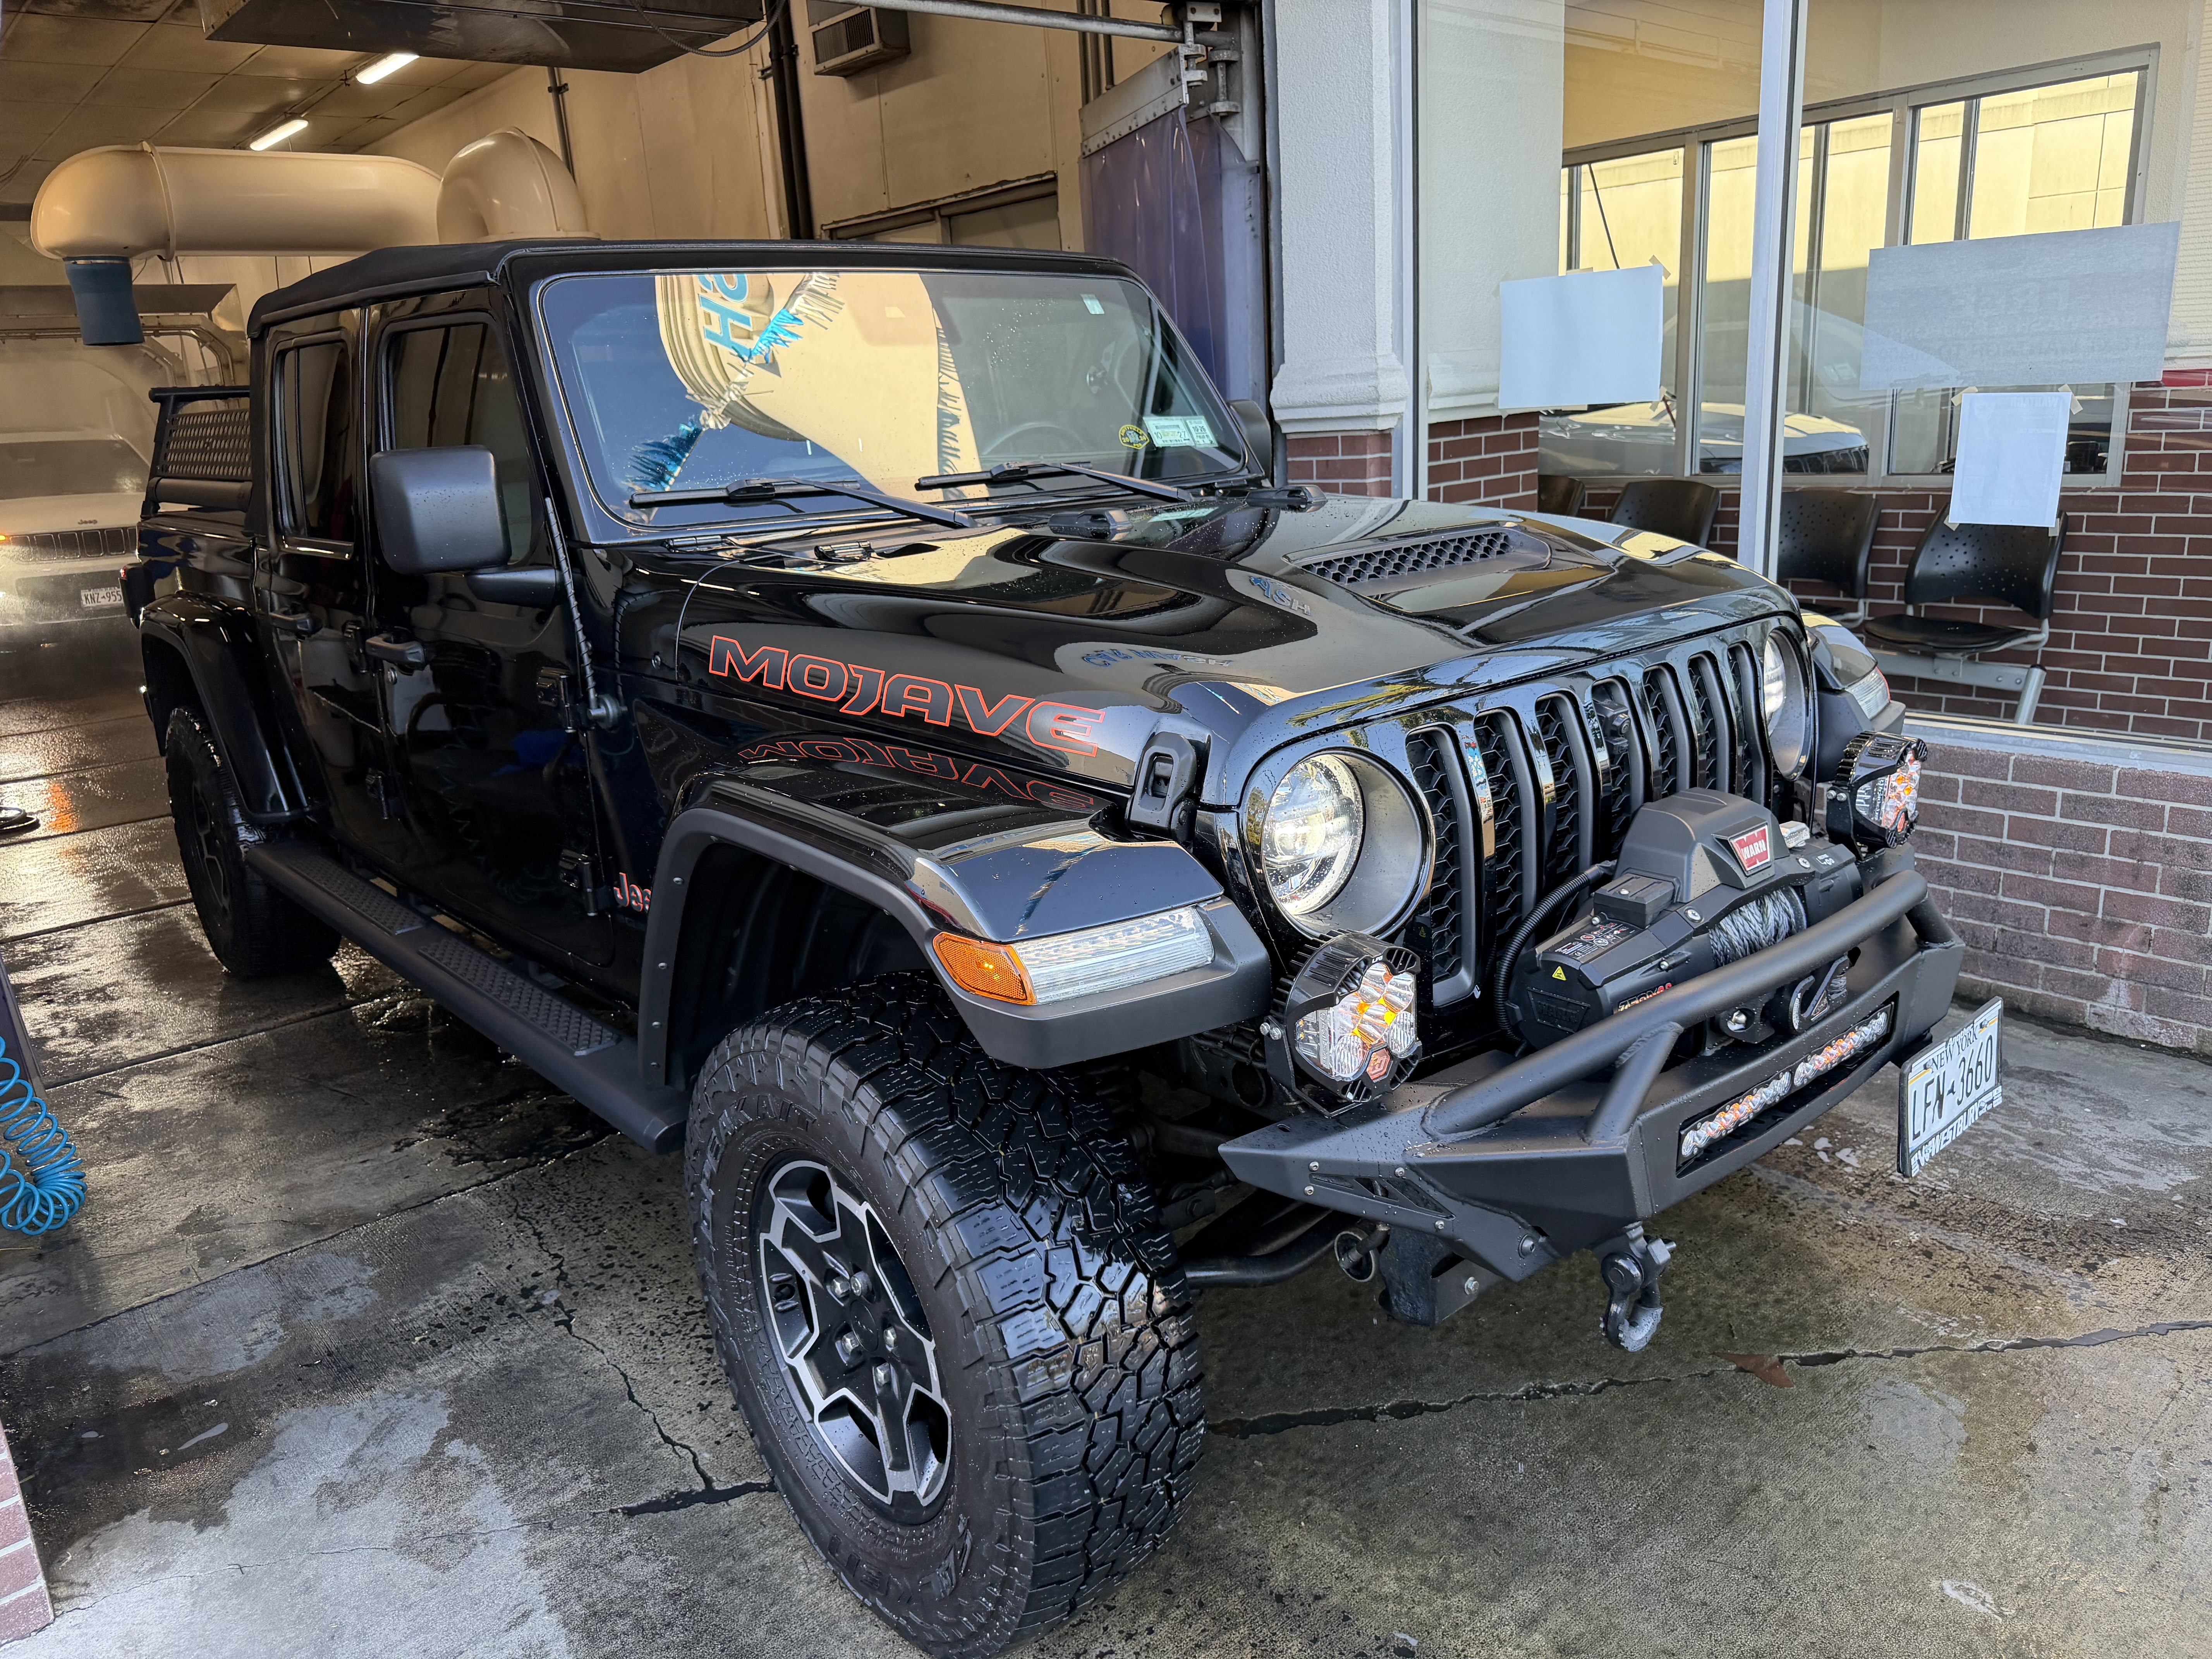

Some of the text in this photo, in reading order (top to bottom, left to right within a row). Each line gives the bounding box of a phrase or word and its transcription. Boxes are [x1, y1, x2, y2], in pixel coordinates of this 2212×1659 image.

[84, 592, 101, 604] KNZ
[709, 635, 1105, 757] MOJAVE
[1741, 839, 1766, 860] WARN
[613, 872, 651, 913] Jee
[1931, 1026, 1978, 1073] NEW YORK
[1957, 1034, 1993, 1106] 3660
[1931, 1101, 1980, 1157] WESTBURY
